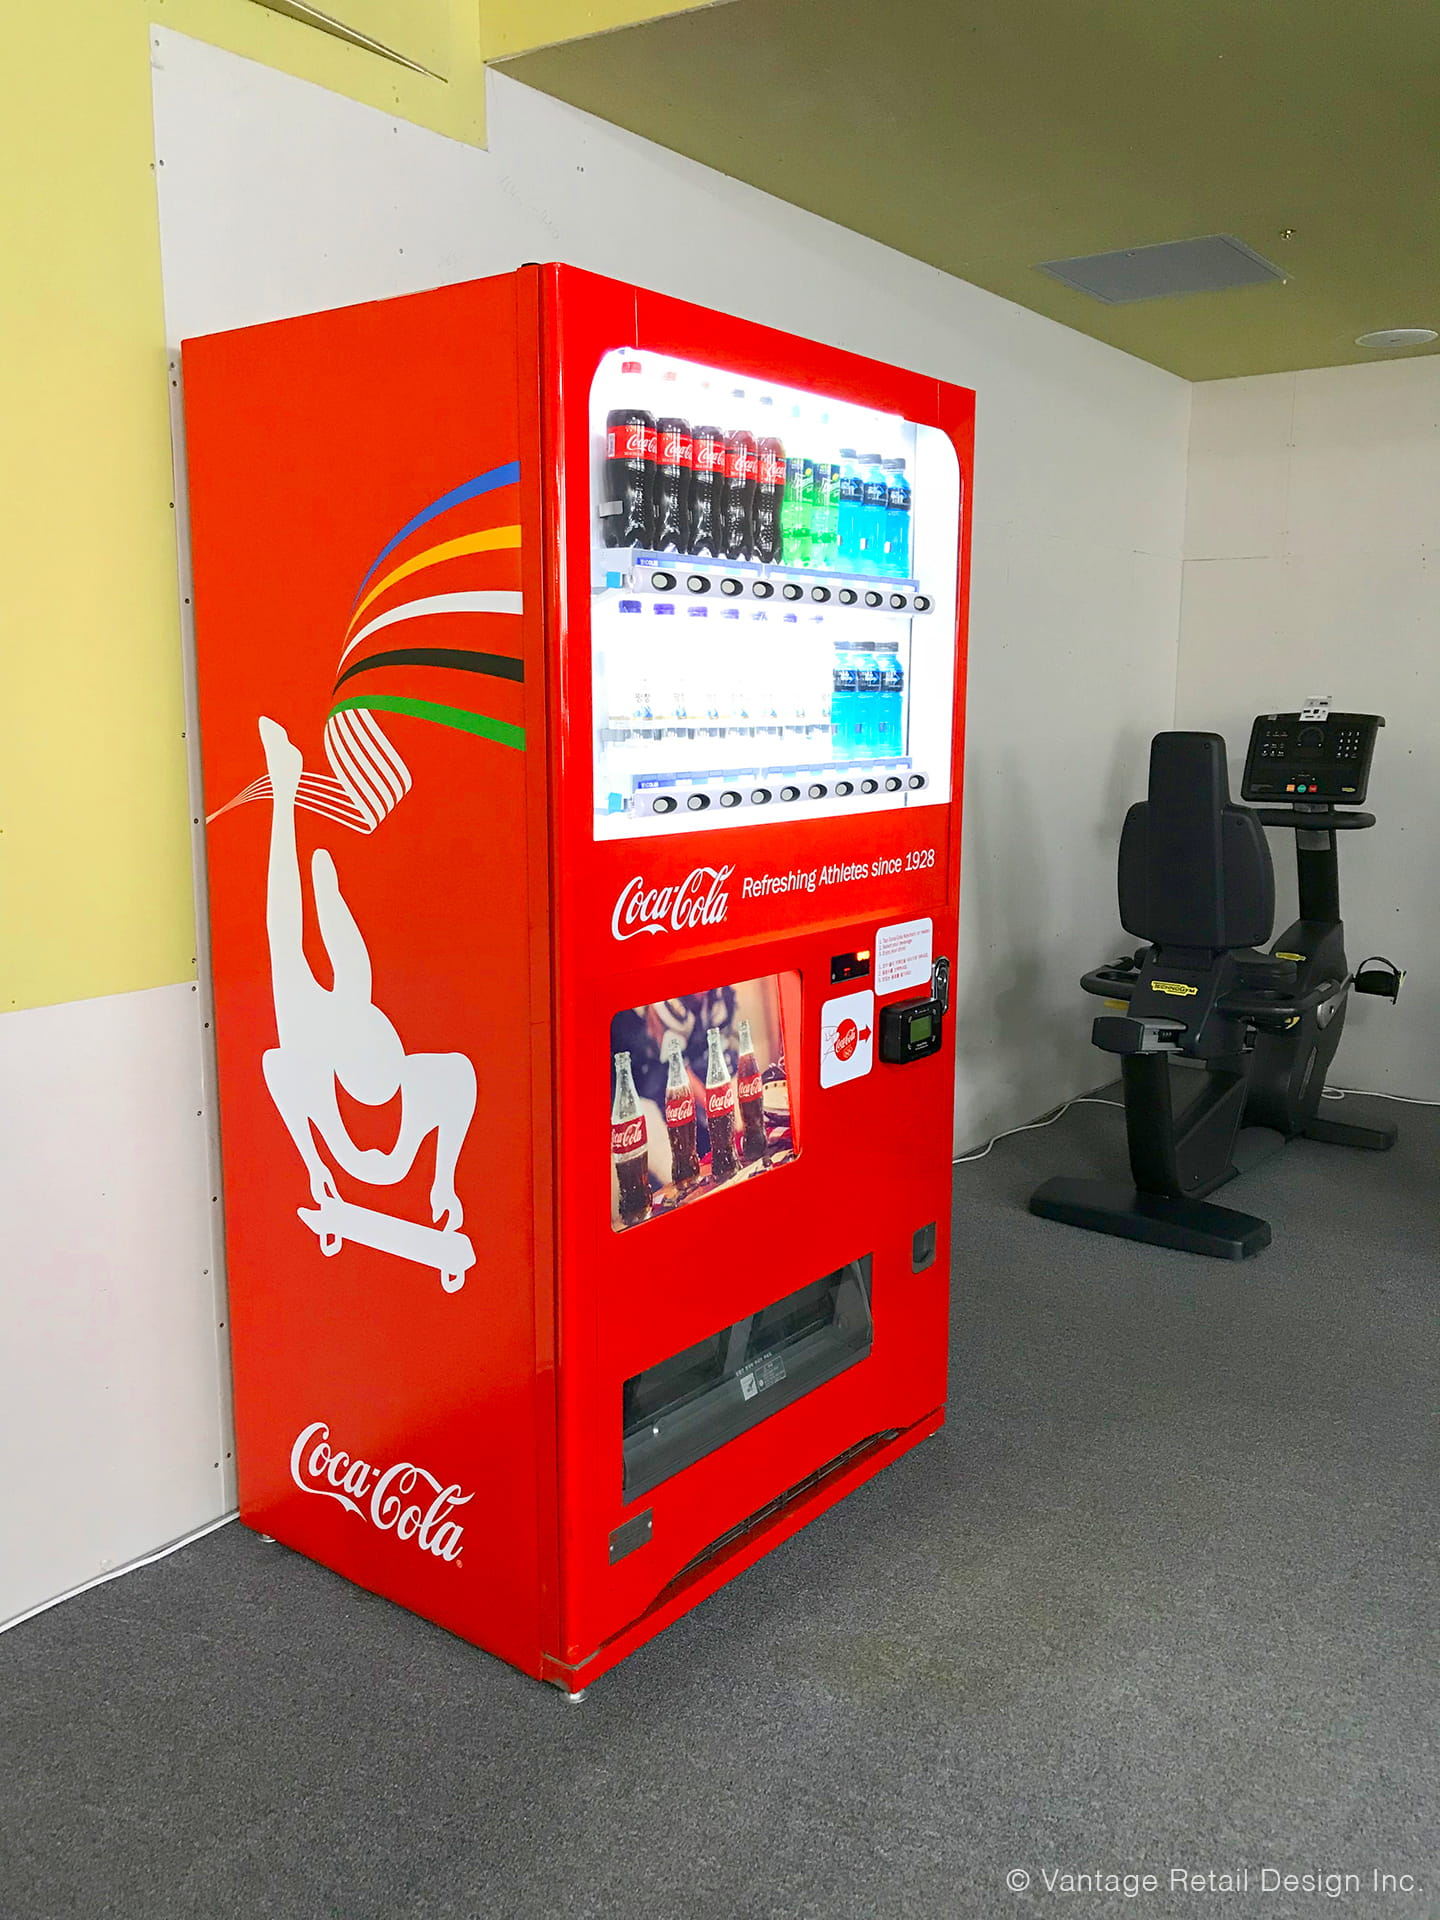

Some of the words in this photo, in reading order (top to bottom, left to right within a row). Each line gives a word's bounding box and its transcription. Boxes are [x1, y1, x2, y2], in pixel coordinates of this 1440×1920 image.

[611, 864, 736, 941] Coca-Cola
[741, 868, 817, 899] Refreshing
[818, 853, 869, 886] Athletes
[871, 857, 902, 877] since
[904, 849, 936, 872] 1928
[290, 1421, 476, 1562] Coca-Cola
